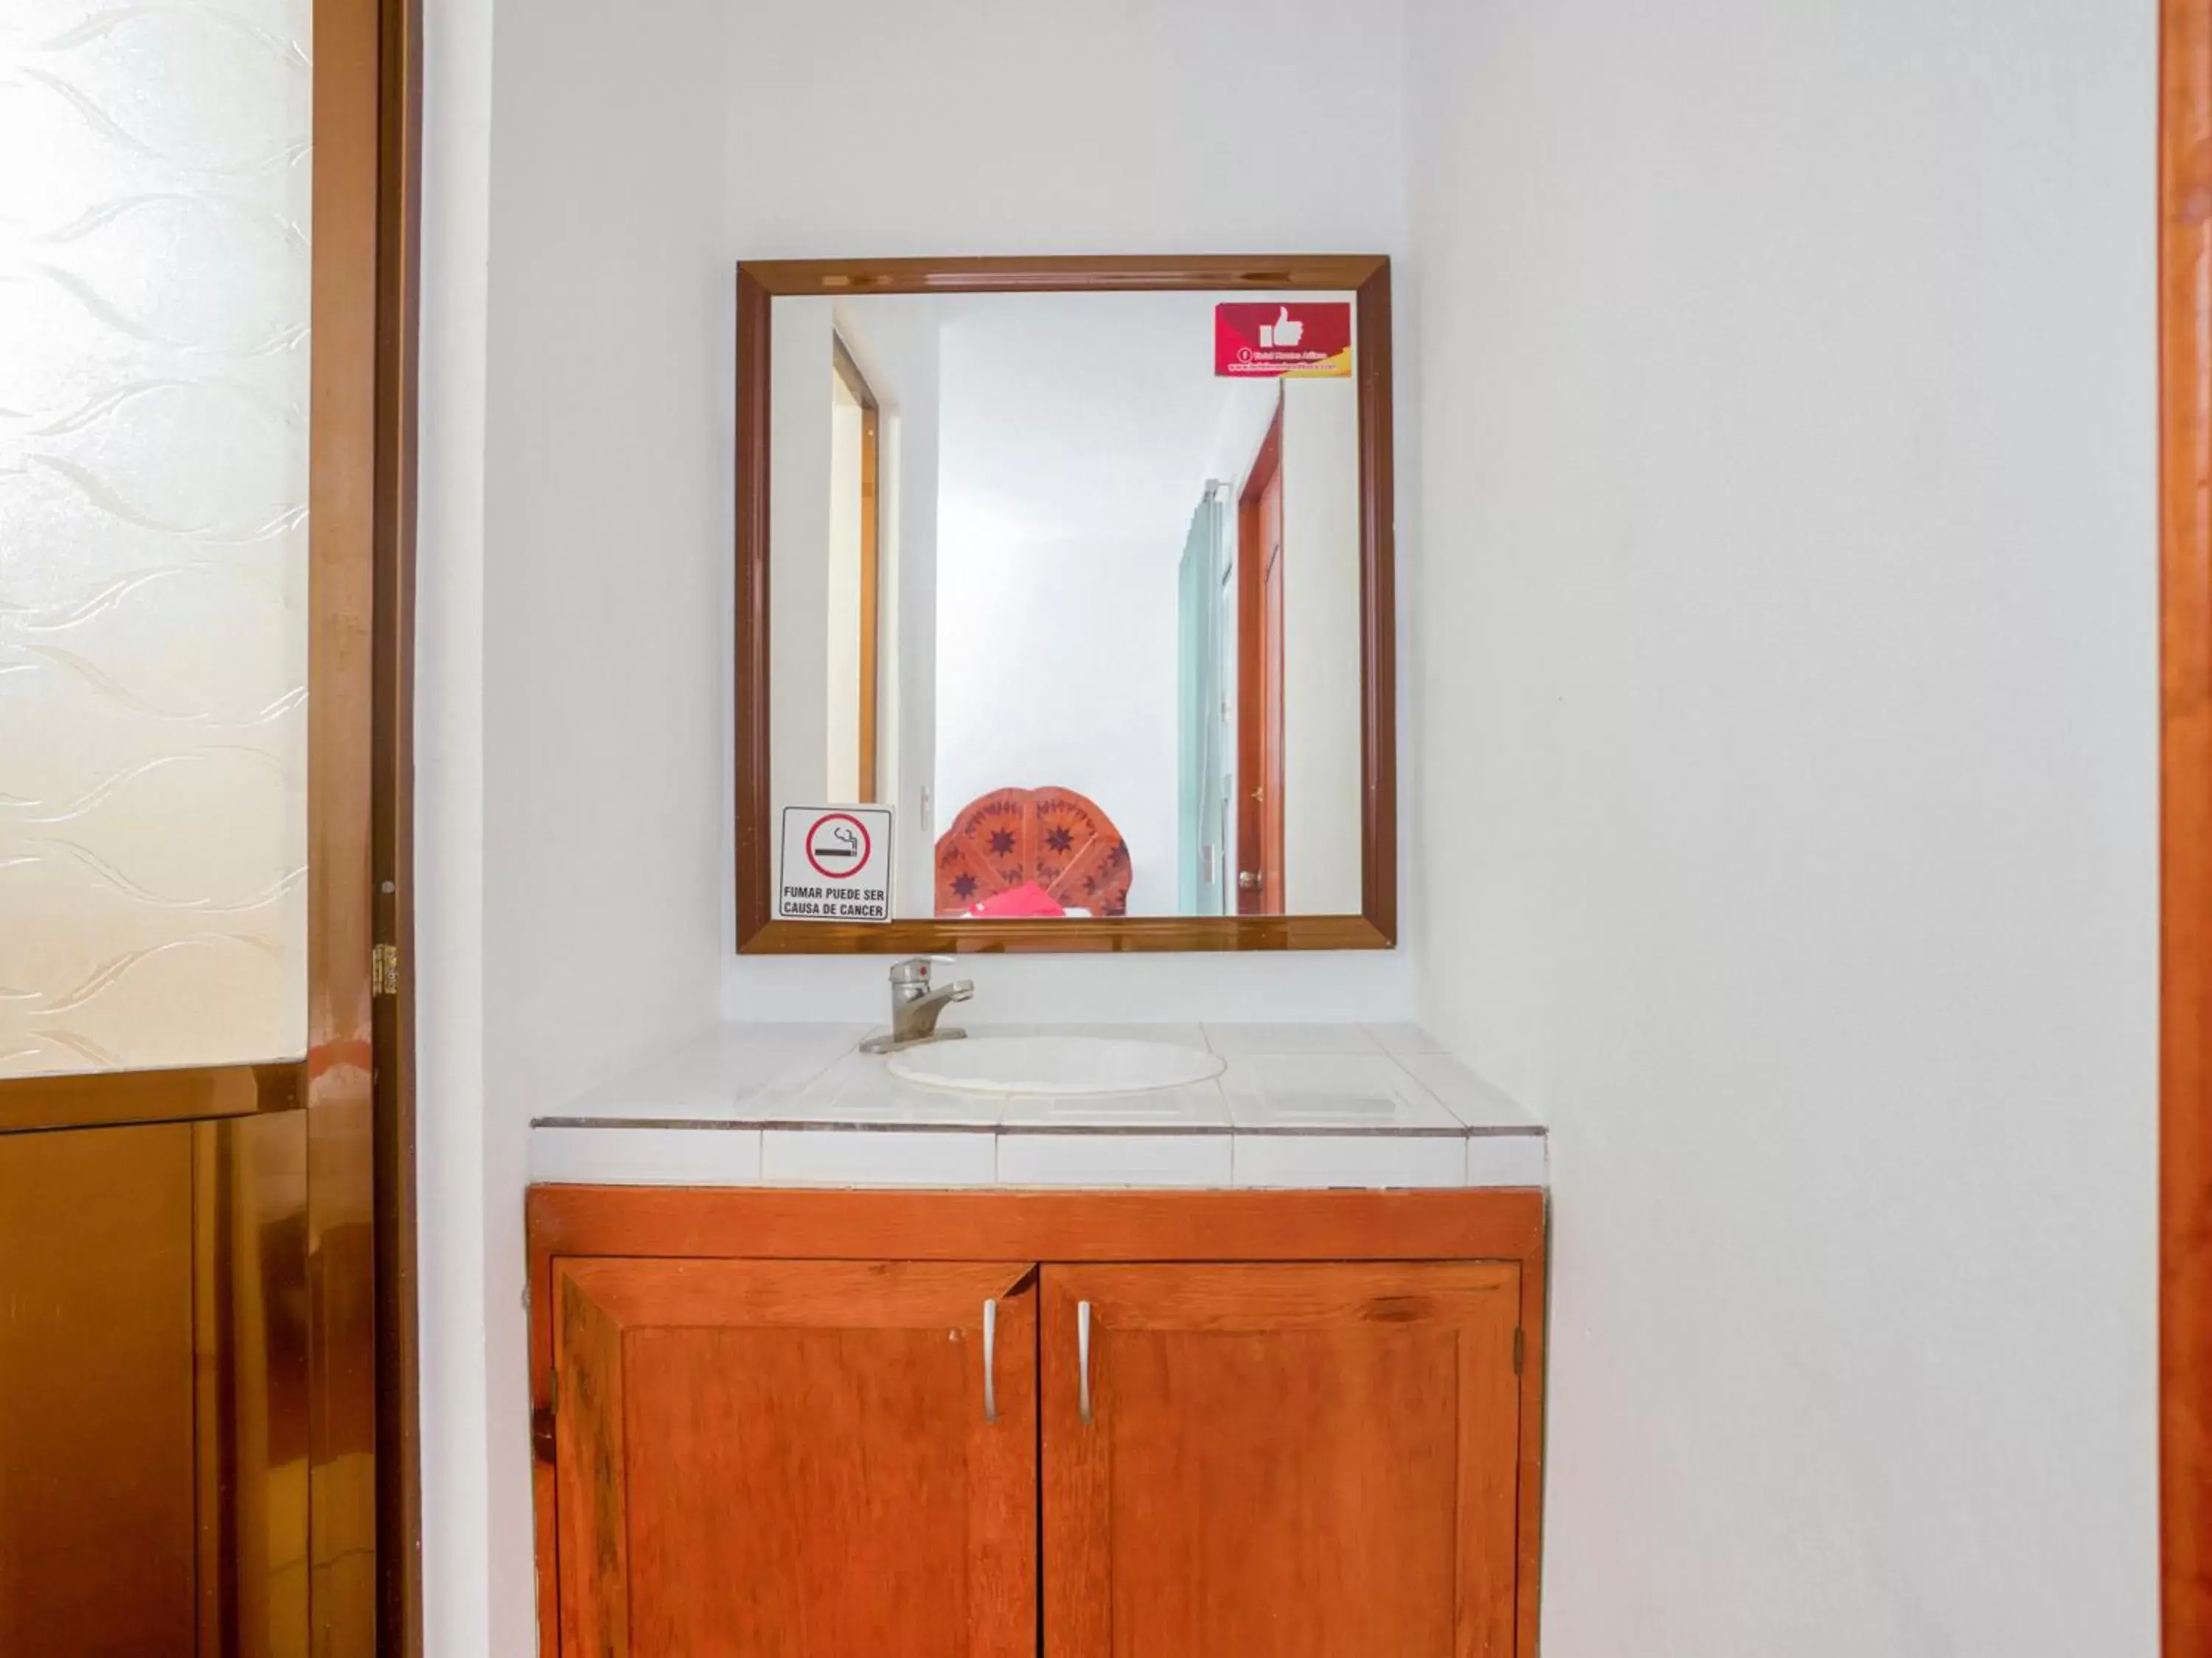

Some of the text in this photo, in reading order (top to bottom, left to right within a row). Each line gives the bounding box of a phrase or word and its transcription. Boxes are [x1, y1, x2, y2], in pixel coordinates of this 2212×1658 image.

[784, 887, 884, 901] FUMAR PUEDE SER
[784, 902, 883, 917] CAUSA DE CANCER
